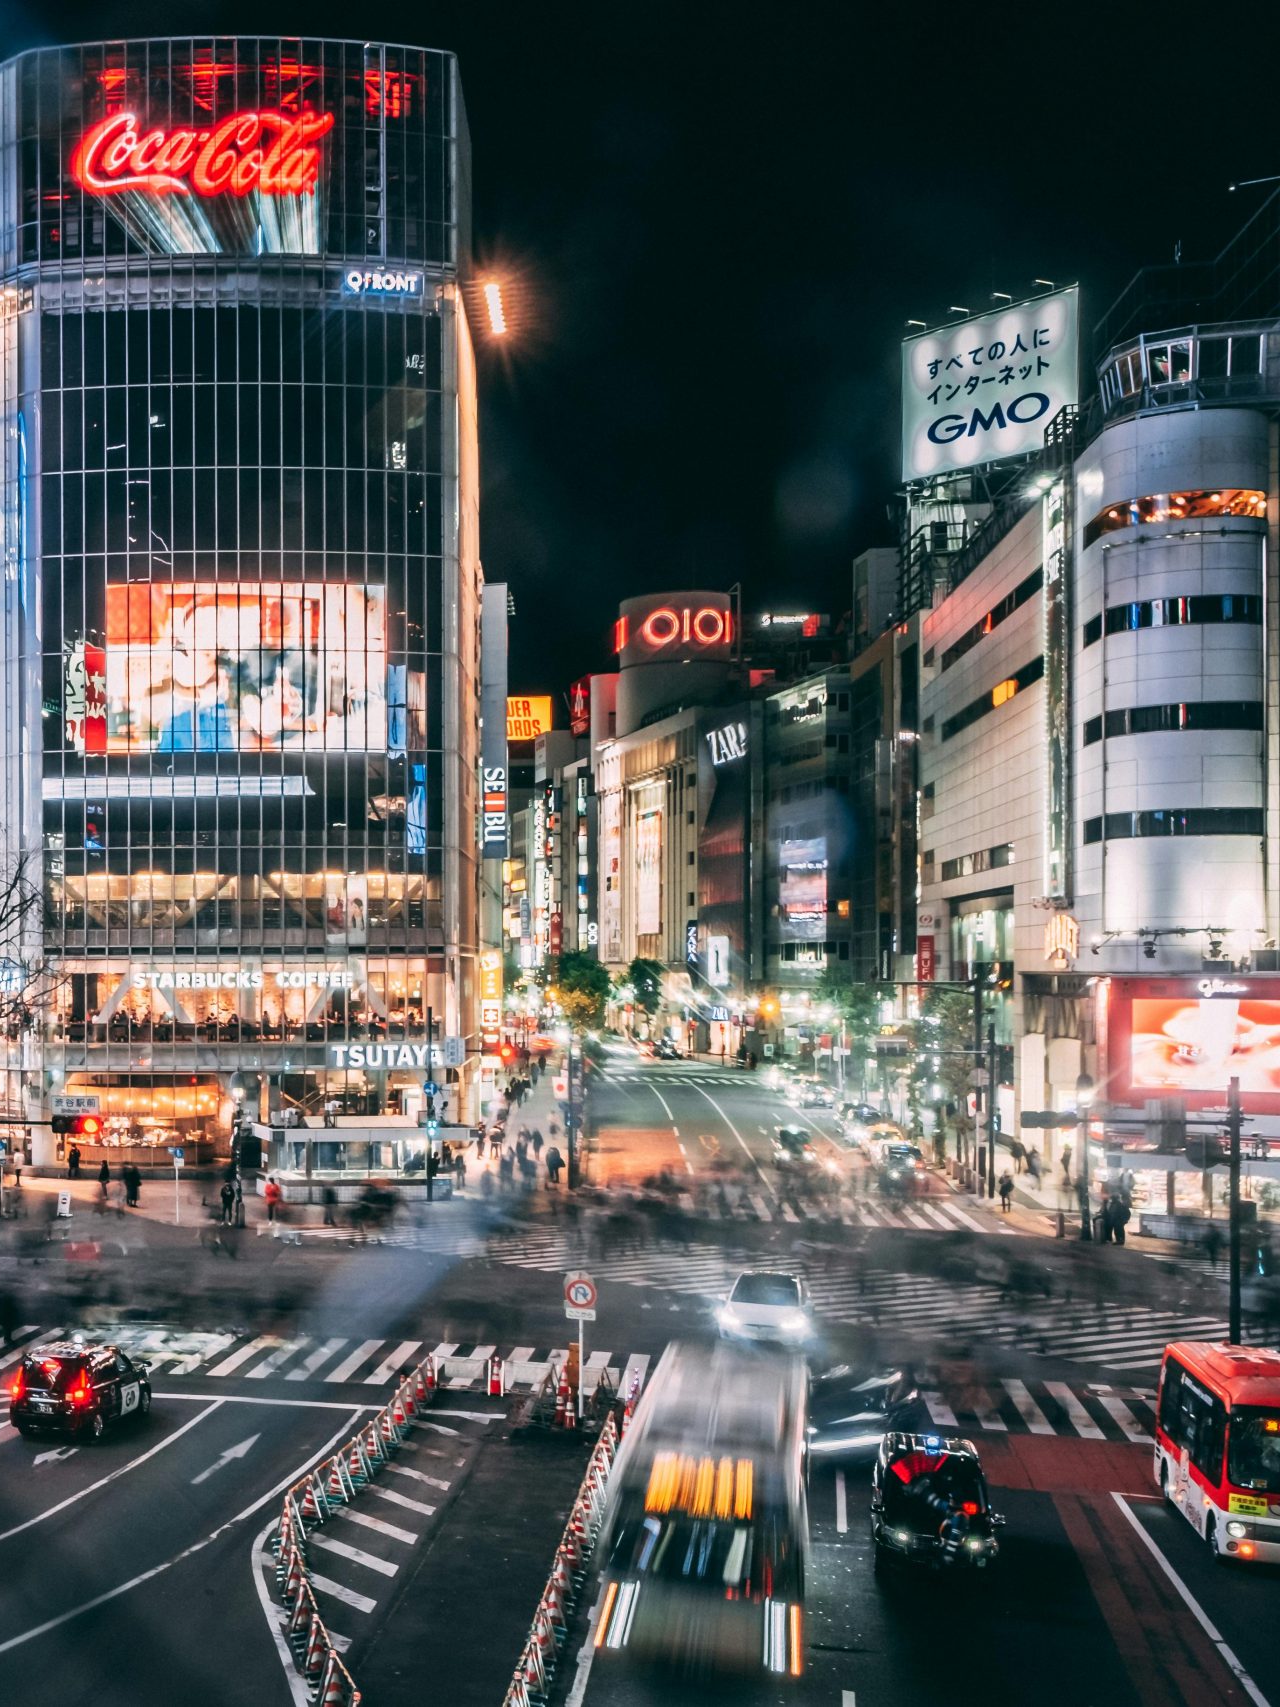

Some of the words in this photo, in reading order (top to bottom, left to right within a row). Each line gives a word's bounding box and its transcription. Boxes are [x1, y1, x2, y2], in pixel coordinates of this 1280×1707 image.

[72, 108, 335, 197] Coca-Cola
[926, 327, 1051, 380] すべての人に
[926, 355, 1051, 405] インターネット
[926, 392, 1051, 445] GMO
[483, 767, 507, 844] SEIBU
[687, 926, 697, 962] ZARA
[133, 970, 264, 989] STARBUCKS
[276, 971, 354, 988] COFFEE
[330, 1044, 444, 1068] TSUTAYA
[55, 1097, 96, 1108] 渋谷駅前
